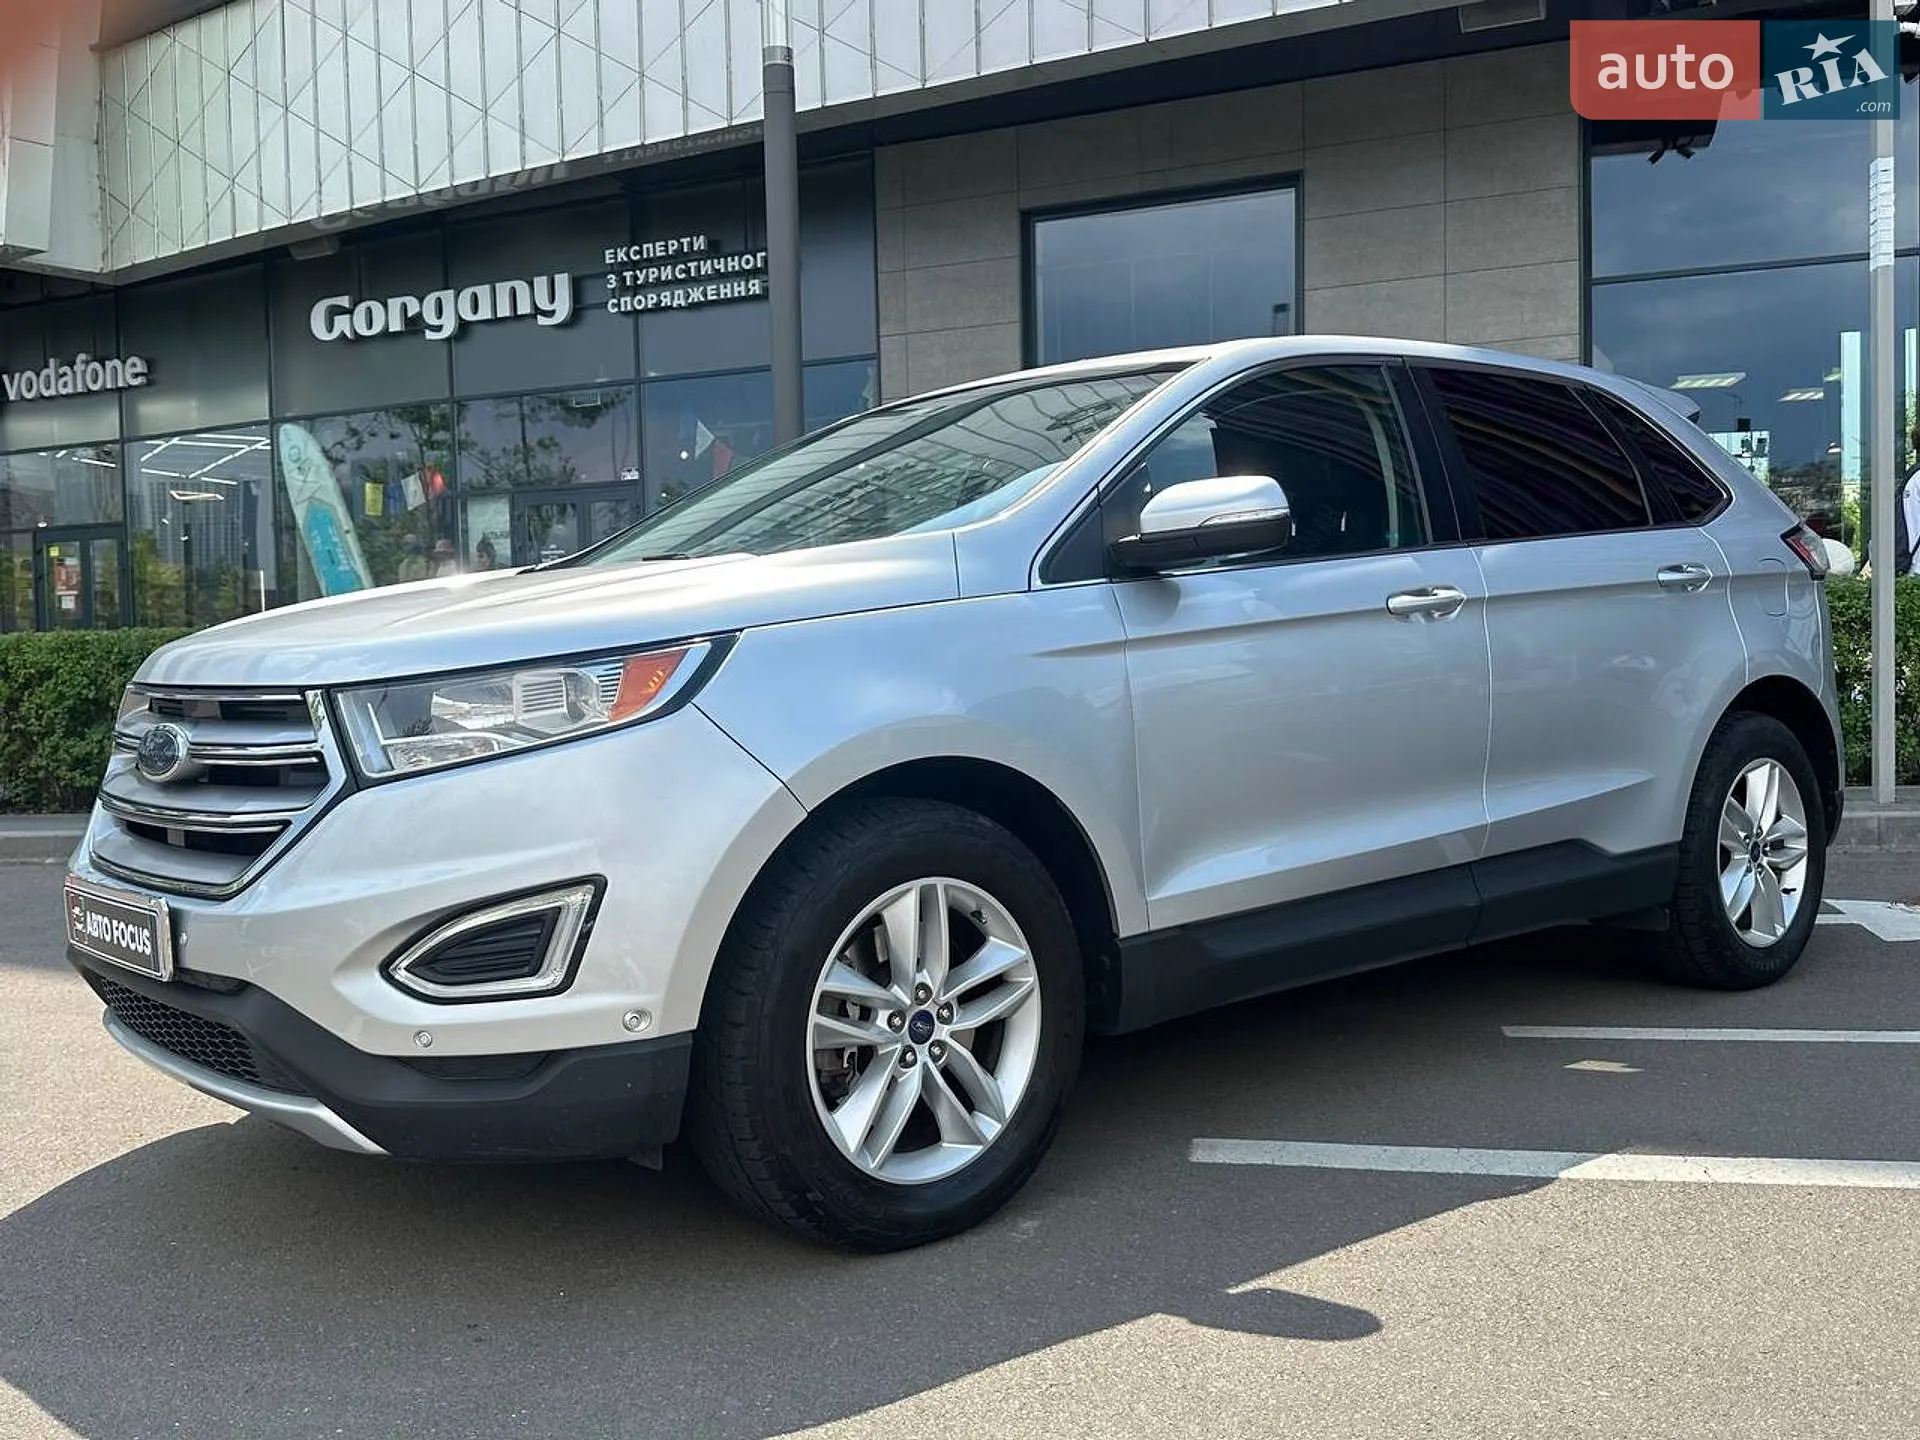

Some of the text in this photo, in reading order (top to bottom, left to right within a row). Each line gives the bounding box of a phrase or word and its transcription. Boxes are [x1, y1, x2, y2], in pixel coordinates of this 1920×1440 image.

[604, 235, 706, 263] ЕКСПЕРТИ
[623, 252, 767, 286] ТУРИСТИЧНОГ
[310, 272, 574, 341] Gorgany
[607, 279, 761, 313] СПОРЯДЖЕННЯ
[2, 353, 148, 400] vodafone
[112, 919, 151, 955] FOCUS
